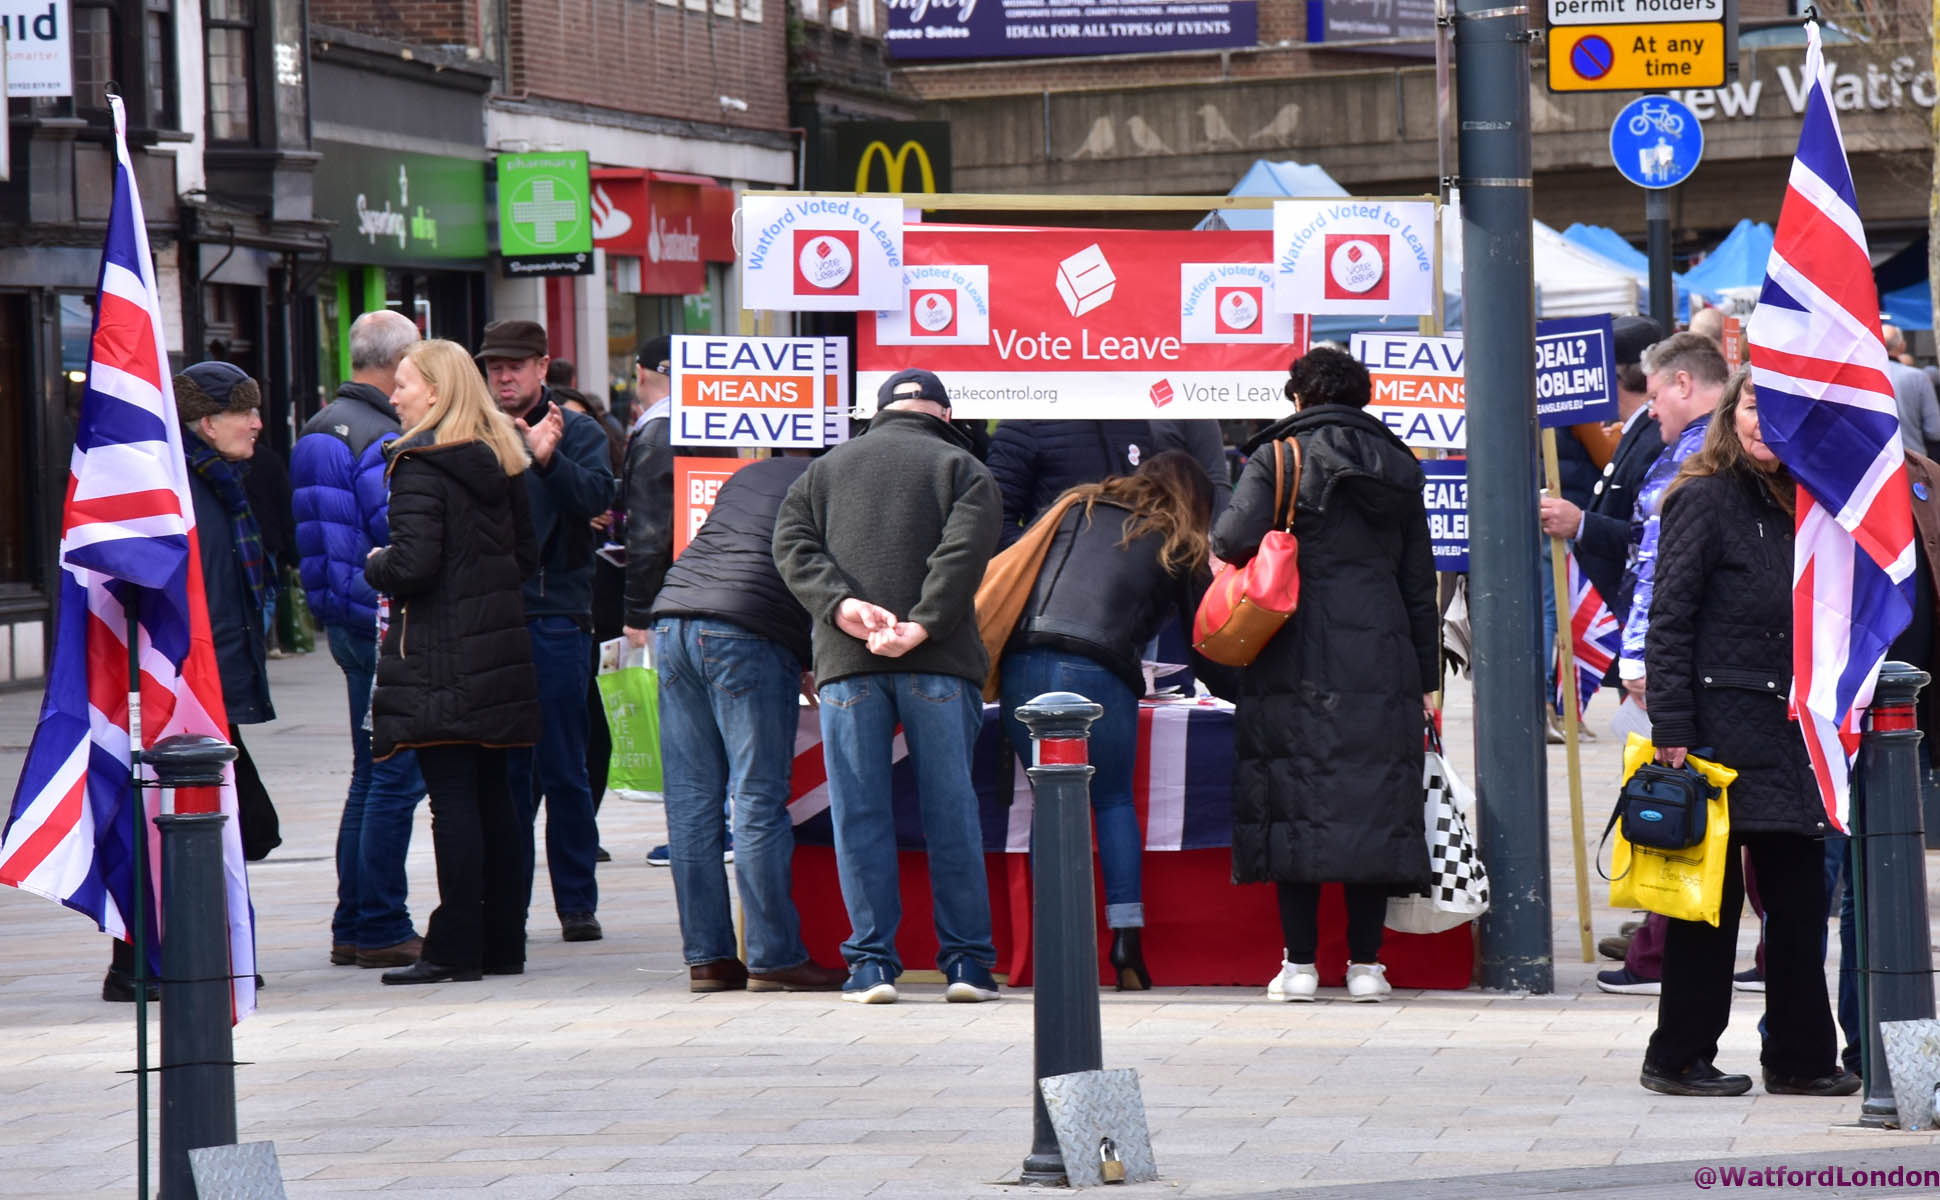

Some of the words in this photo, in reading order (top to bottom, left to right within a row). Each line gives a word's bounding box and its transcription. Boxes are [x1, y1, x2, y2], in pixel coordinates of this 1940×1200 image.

[1555, 0, 1624, 16] permit
[1006, 24, 1049, 38] IDEAL
[1050, 23, 1080, 38] FOR
[1082, 23, 1109, 37] ALL
[1109, 22, 1153, 36] TYPES
[1154, 21, 1174, 36] OF
[1177, 20, 1231, 35] EVENTS
[1632, 36, 1656, 53] At
[1667, 38, 1704, 56] any
[1645, 59, 1692, 76] time
[1668, 79, 1763, 121] ew
[506, 156, 577, 172] pharmacy
[748, 208, 797, 271] Watford
[796, 199, 850, 217] Voted
[851, 207, 870, 226] to
[868, 220, 901, 269] Leave
[1279, 212, 1328, 275] Watford
[1327, 203, 1382, 221] Voted
[1383, 210, 1401, 229] to
[1401, 224, 1431, 273] Leave
[510, 261, 581, 274] Superdrug
[911, 268, 951, 280] Voted
[952, 272, 966, 286] to
[964, 281, 987, 317] Leave
[1182, 271, 1217, 317] Watford
[1217, 265, 1256, 277] Voted
[1258, 270, 1271, 284] to
[681, 341, 814, 371] LEAVE
[993, 329, 1072, 361] Vote
[1082, 329, 1180, 361] Leave
[1360, 340, 1465, 371] LEAV
[697, 380, 799, 403] MEANS
[947, 386, 1058, 404] takecontrol.org
[1182, 383, 1230, 402] Vote
[1236, 383, 1284, 402] Leav
[1537, 400, 1584, 415] EANSLEAVE.EU
[680, 411, 814, 441] LEAVE
[1382, 411, 1466, 442] EAV
[1424, 483, 1468, 509] EAL?
